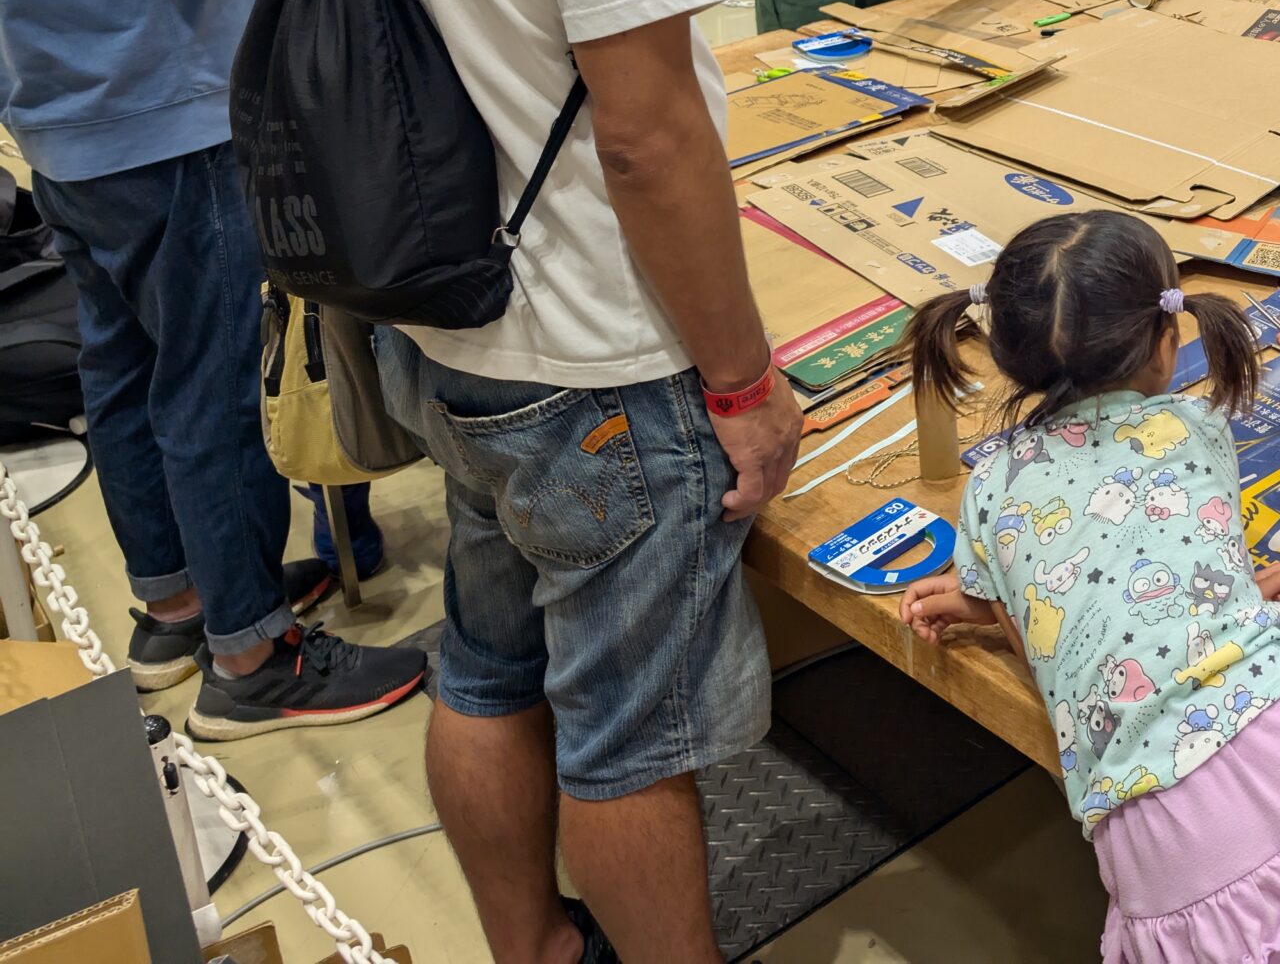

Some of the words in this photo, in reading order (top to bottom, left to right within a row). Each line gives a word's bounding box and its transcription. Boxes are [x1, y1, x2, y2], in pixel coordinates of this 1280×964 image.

[885, 502, 904, 515] 03
[859, 516, 913, 555] ナイスタック
